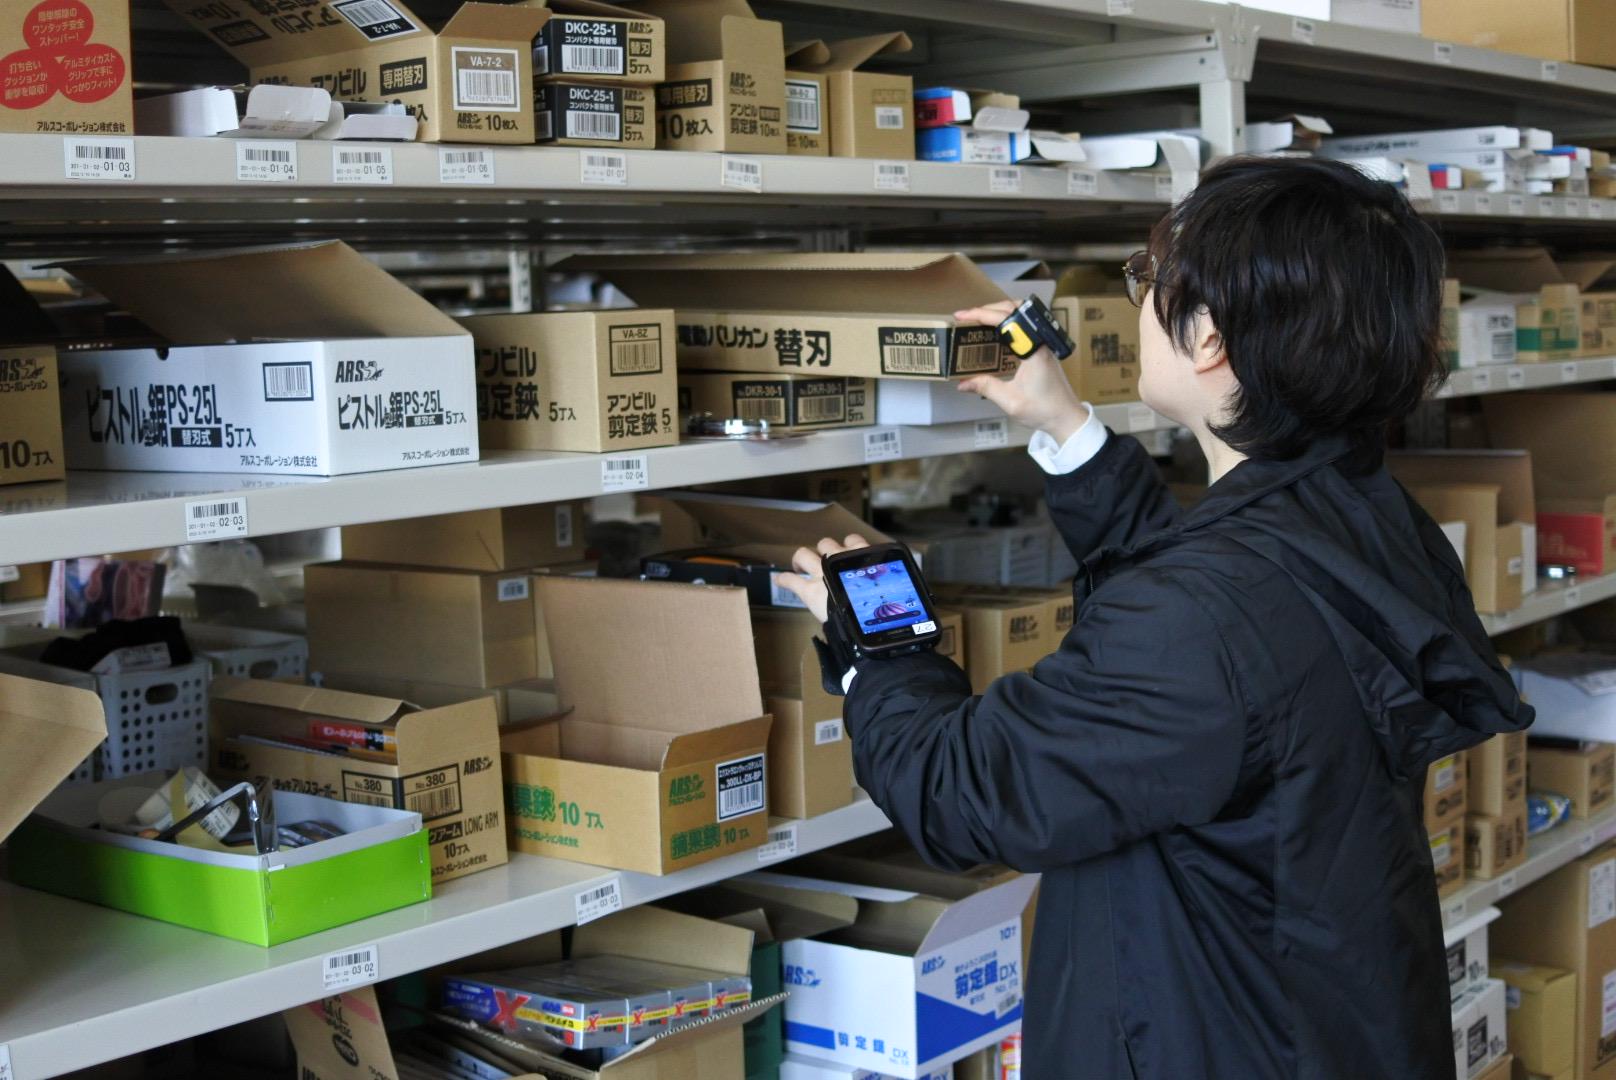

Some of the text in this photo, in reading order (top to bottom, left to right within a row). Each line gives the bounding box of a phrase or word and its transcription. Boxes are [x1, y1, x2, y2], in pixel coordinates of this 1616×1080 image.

[565, 22, 617, 36] DKC-25-1
[64, 53, 116, 69] アルミダイカスト
[470, 56, 502, 67] VA-7-2
[629, 59, 652, 74] 5丁入
[382, 64, 424, 90] 専用替刃
[569, 88, 614, 102] DKC-25-1
[729, 103, 758, 117] アンビル
[37, 121, 126, 132] アルスコーポレーション株式会社
[624, 126, 644, 141] 5丁入
[622, 327, 649, 339] VA-8Z
[893, 332, 937, 345] DKR-30-1
[773, 327, 832, 368] 替刃
[0, 358, 20, 382] RS
[335, 361, 364, 383] ARS
[606, 391, 656, 412] アンビル
[414, 410, 467, 427] 替刃式 5丁入
[549, 401, 577, 422] 5丁入
[608, 408, 672, 439] 剪定鋏 5
[181, 423, 257, 448] 替刃式 5丁入
[240, 454, 318, 468] アルスコーポレーション株式会社
[402, 448, 470, 461] アルスコーポレーション株式会社
[219, 516, 230, 528] 02
[232, 515, 244, 526] 03
[363, 778, 382, 792] 380
[425, 772, 446, 788] 380
[559, 801, 580, 827] 10
[464, 815, 483, 836] LONG
[352, 966, 362, 976] 03
